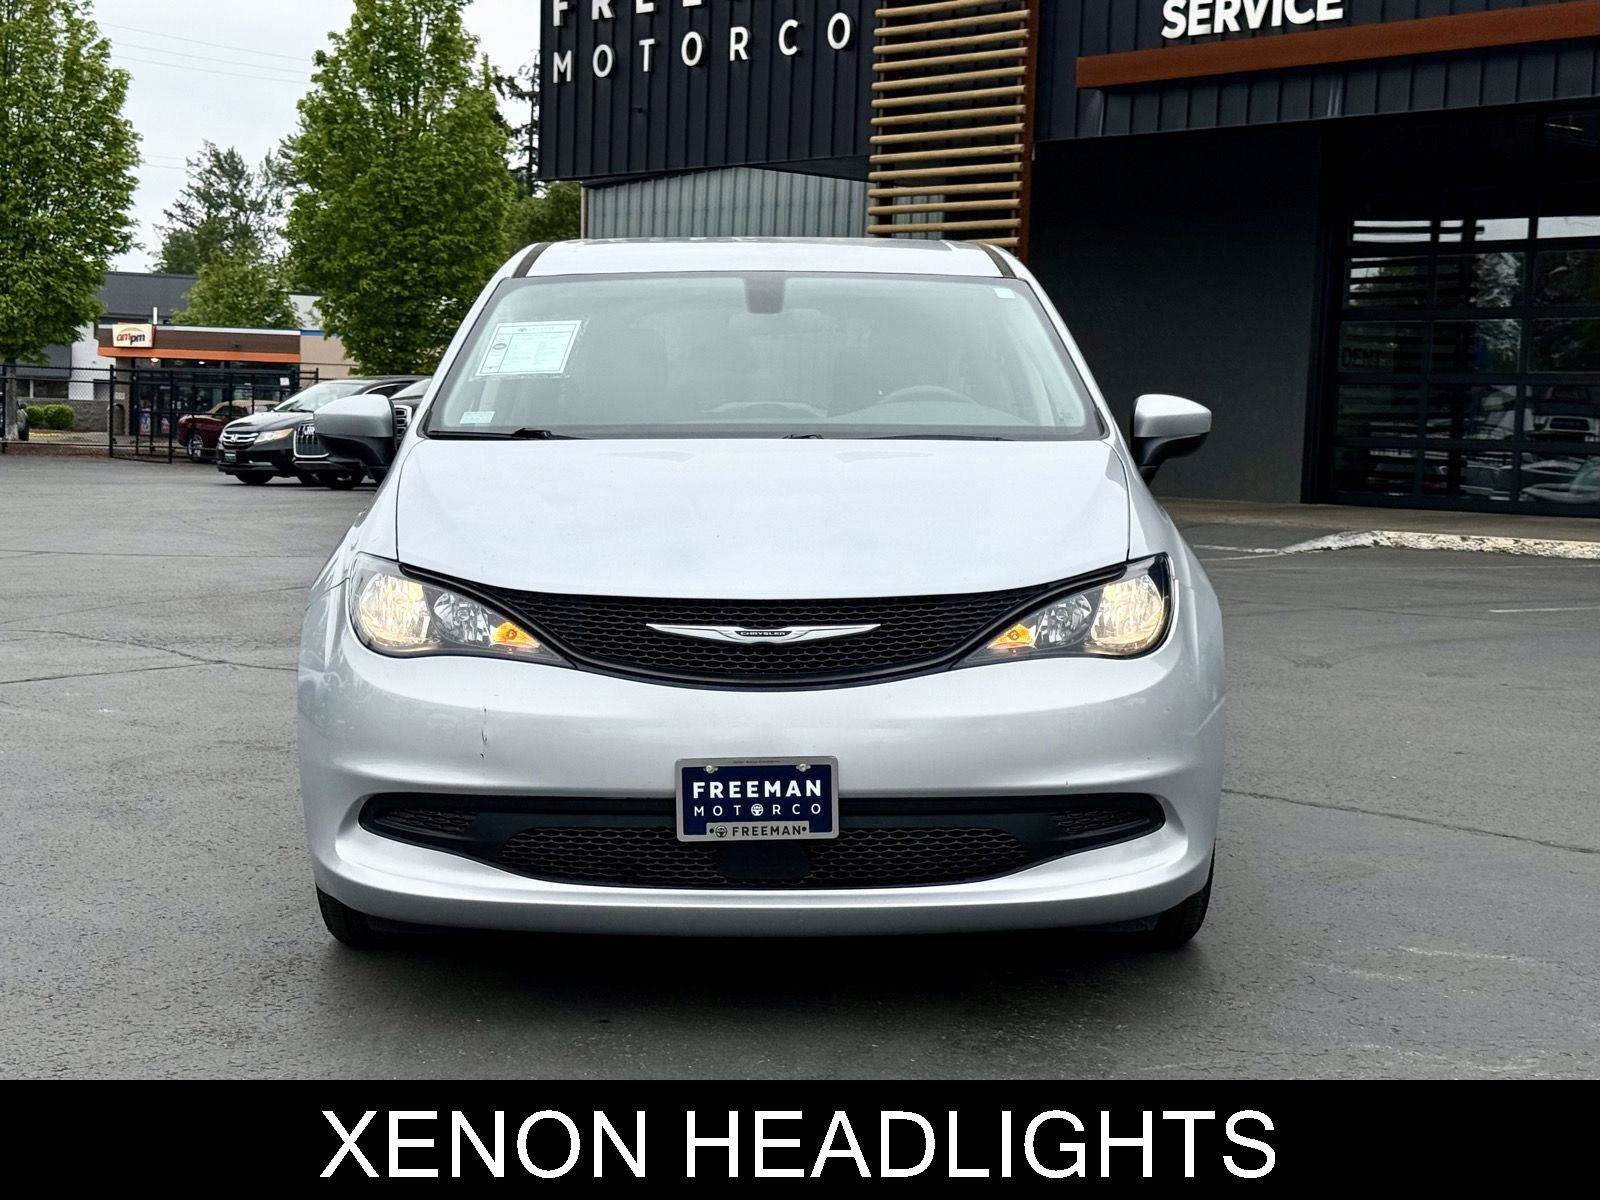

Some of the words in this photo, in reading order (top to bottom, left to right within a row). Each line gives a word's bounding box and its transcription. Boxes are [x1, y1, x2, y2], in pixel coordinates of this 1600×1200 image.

[552, 12, 851, 84] MOTORCO
[116, 333, 146, 345] ampm
[692, 780, 821, 799] FREEMAN
[732, 825, 800, 837] FREEMAN
